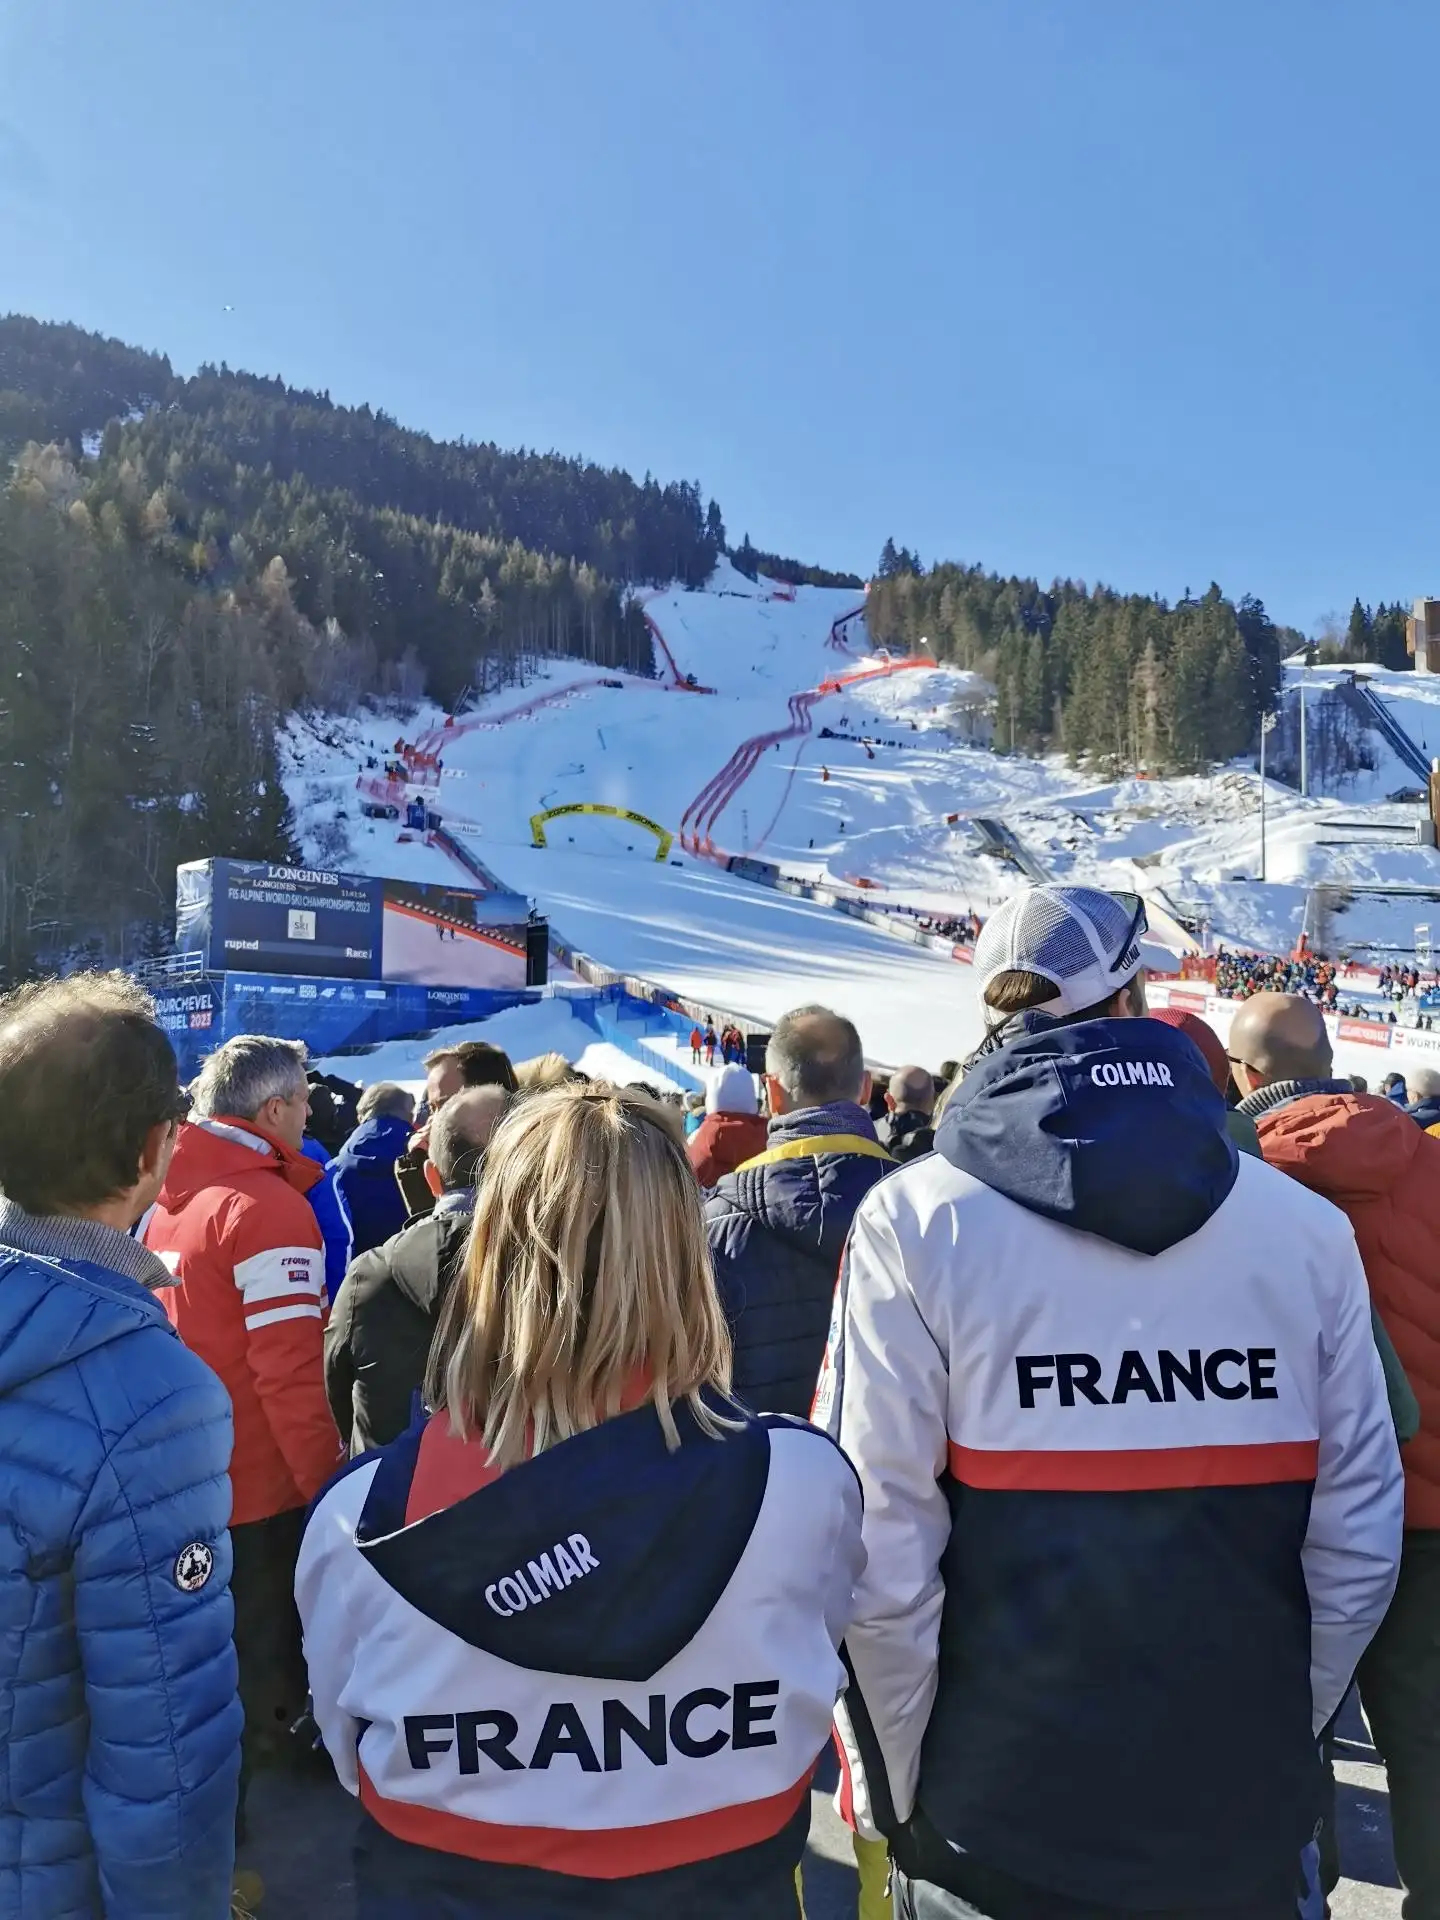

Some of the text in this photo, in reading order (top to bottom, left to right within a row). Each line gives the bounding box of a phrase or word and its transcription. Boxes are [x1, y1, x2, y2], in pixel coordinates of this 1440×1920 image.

[252, 879, 297, 892] LONGINES
[267, 866, 339, 886] LONGINES
[228, 887, 371, 914] FIS ALPINE WORLD SKI CHAMPIONSHIPS 2023
[294, 921, 309, 931] SKI
[224, 939, 259, 951] rupted
[345, 947, 368, 959] Race
[427, 991, 470, 1001] LONGINES
[190, 1010, 212, 1028] 2023
[1091, 1061, 1175, 1087] COLMAR
[1015, 1347, 1279, 1409] FRANCE
[484, 1532, 601, 1617] COLMAR
[403, 1679, 780, 1775] FRANCE
